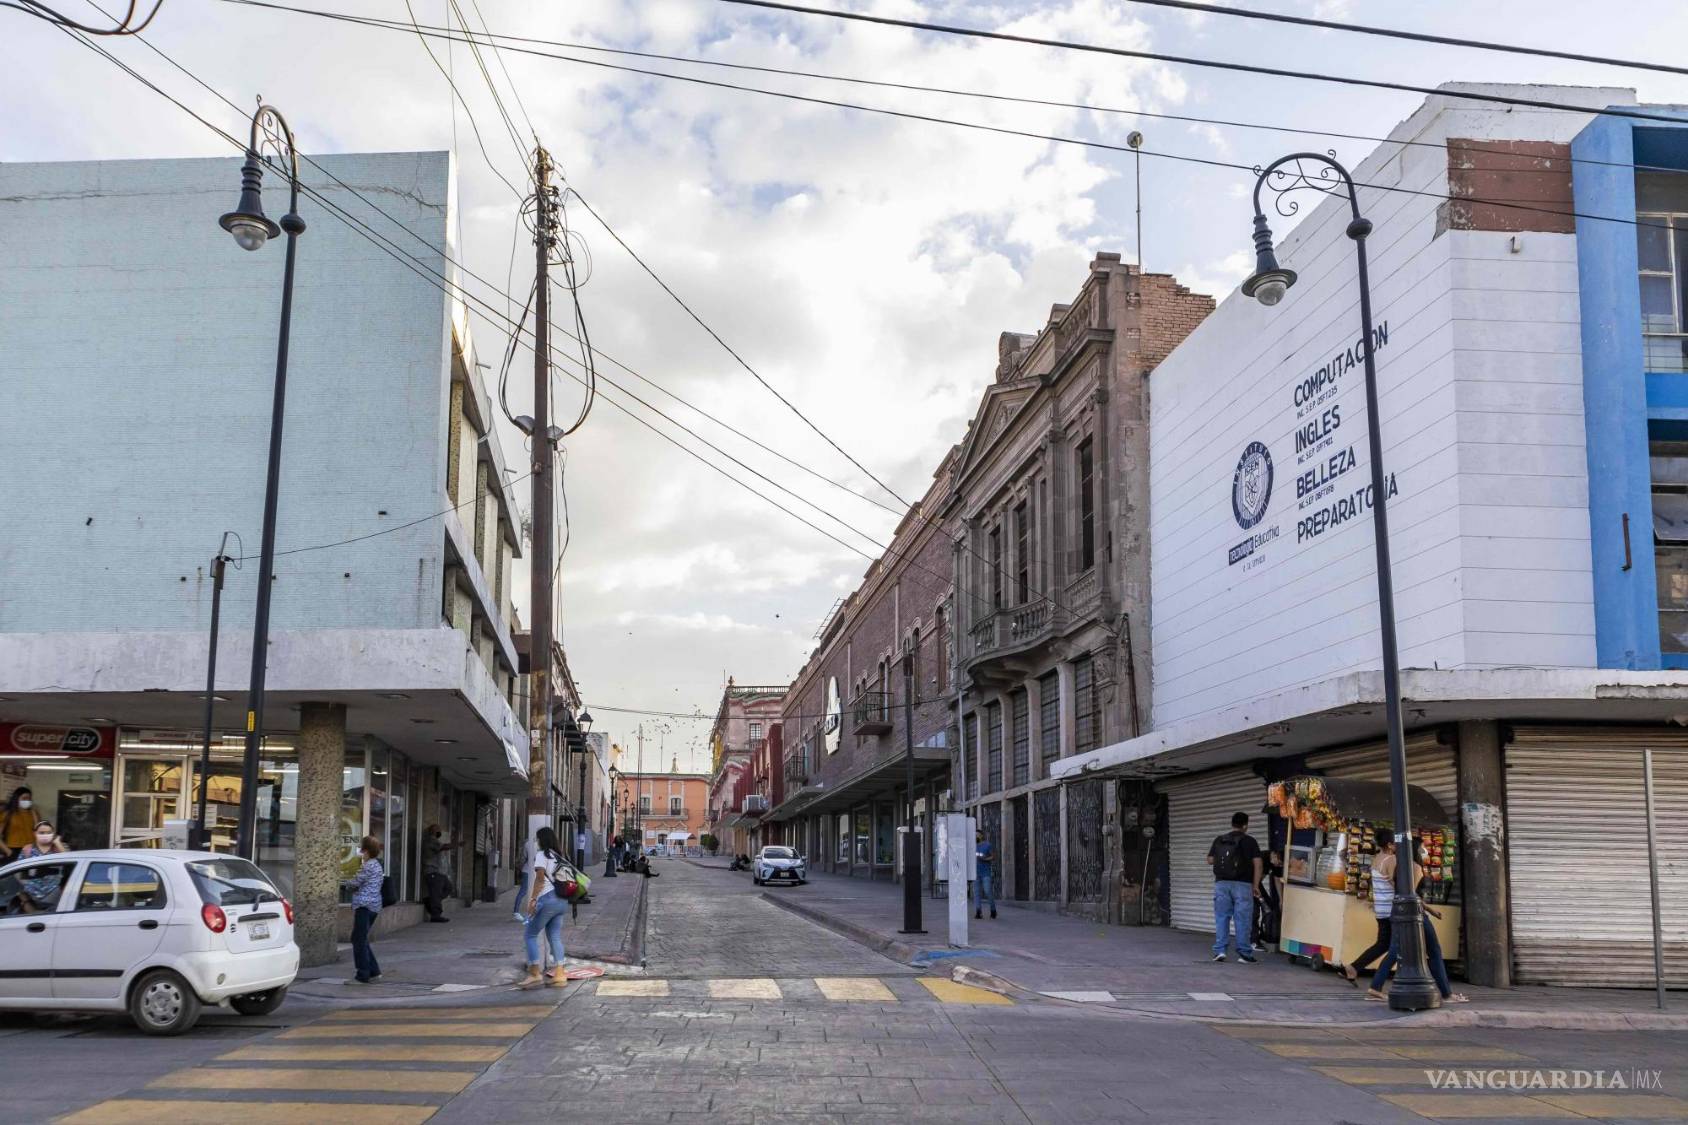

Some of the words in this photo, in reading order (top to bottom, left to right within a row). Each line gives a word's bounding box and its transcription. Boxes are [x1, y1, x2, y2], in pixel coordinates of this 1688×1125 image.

[1294, 320, 1388, 407] COMPUTACON
[1295, 404, 1340, 453] INGLES
[1296, 445, 1356, 499] BELLEZA
[1298, 472, 1398, 543] PREPARATOIA
[17, 731, 64, 746] super
